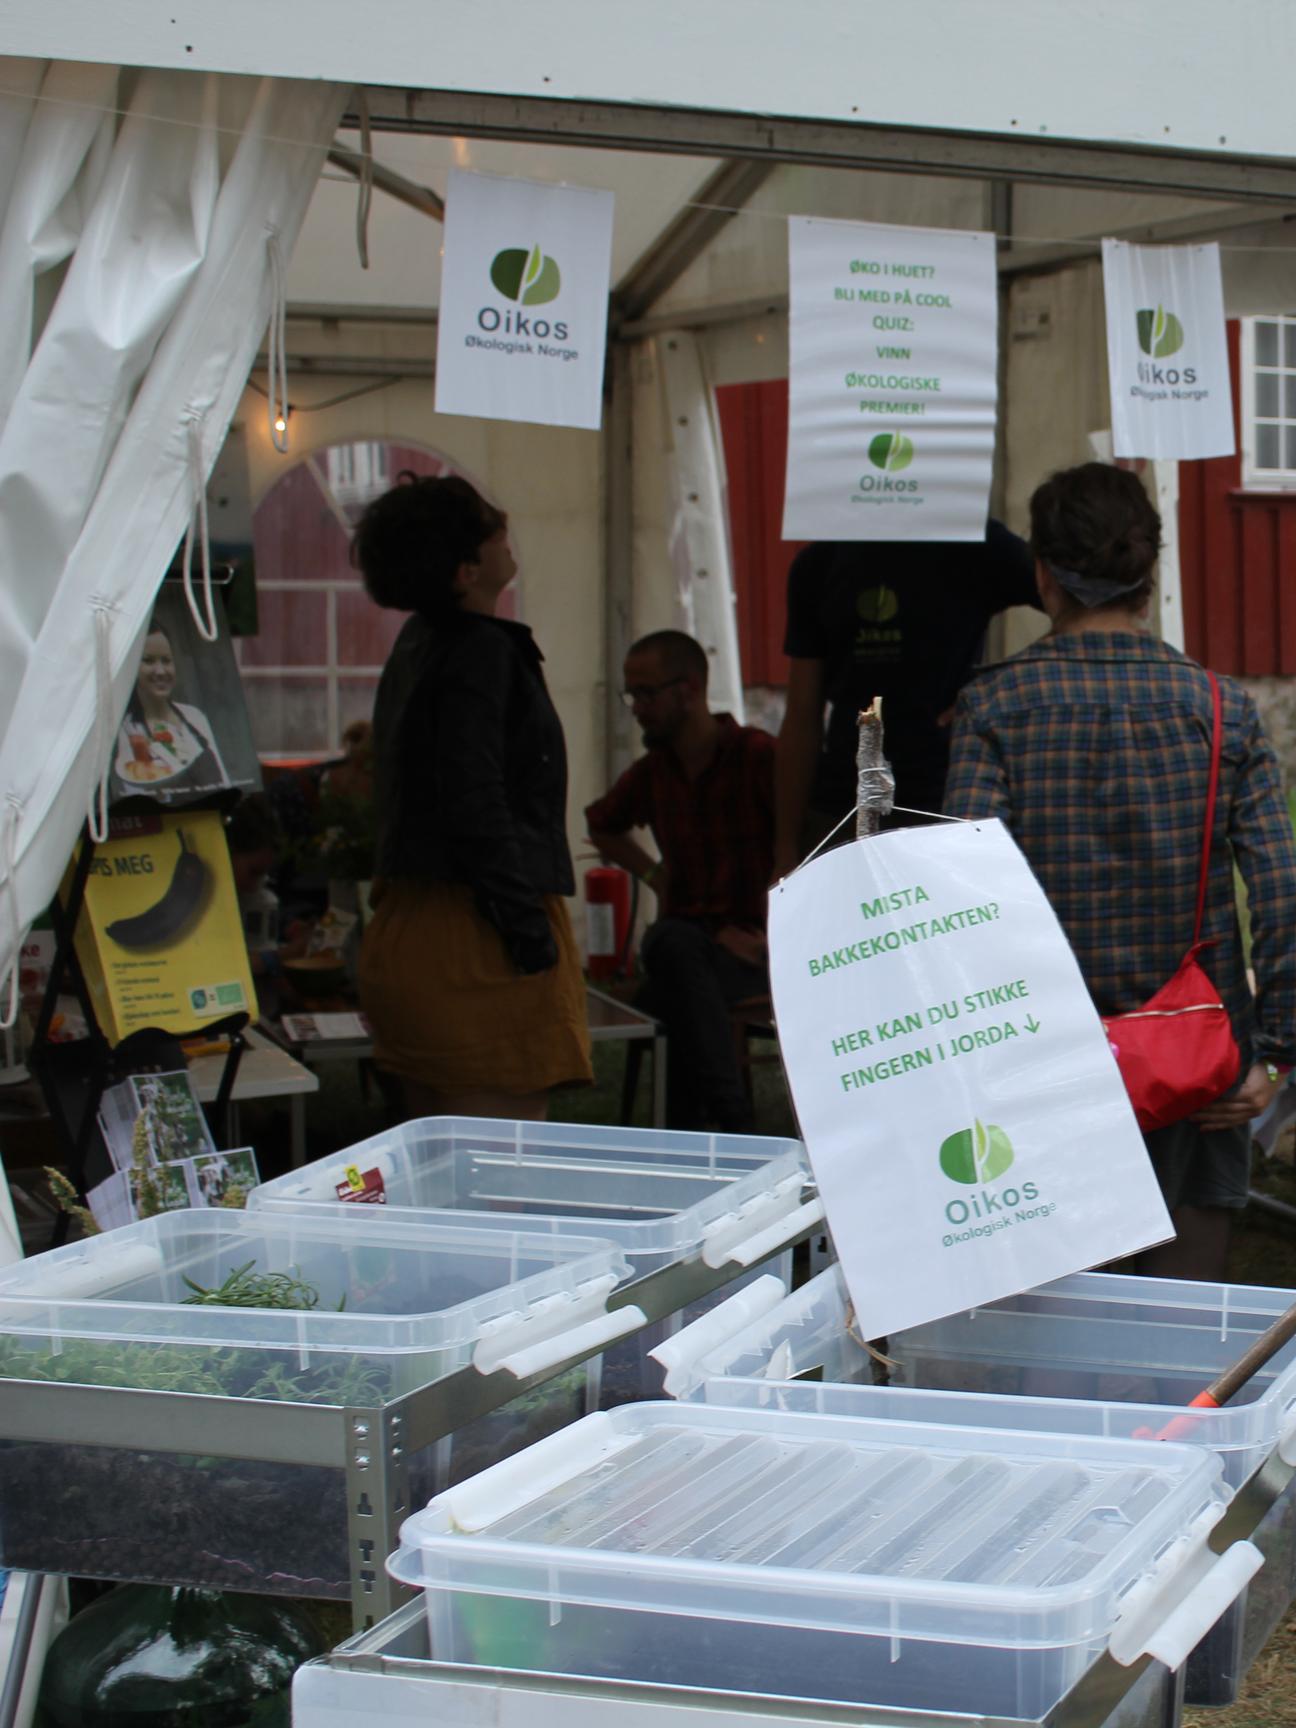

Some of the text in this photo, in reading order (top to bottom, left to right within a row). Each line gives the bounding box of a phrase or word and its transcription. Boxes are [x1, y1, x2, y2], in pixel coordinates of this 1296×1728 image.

[849, 259, 880, 274] ØKO
[892, 264, 936, 279] HUET?
[834, 287, 952, 308] BLI MED PÅ COOL
[477, 307, 569, 341] Oikos
[464, 335, 579, 361] Økologisk Norge
[876, 346, 911, 360] VINN
[845, 372, 941, 392] ØKOLOGISKE
[860, 400, 926, 415] PREMIER!
[859, 474, 919, 492] Oikos
[114, 854, 154, 876] MEG
[860, 885, 930, 920] MISTA
[808, 902, 1001, 977] BAKKEKONTAKTEN?
[831, 979, 1029, 1057] HER KAN DU STIKKE
[840, 1021, 1018, 1092] FINGERN I JORDA
[944, 1181, 1039, 1225] Oikos
[942, 1202, 1057, 1248] Økologisk Norge
